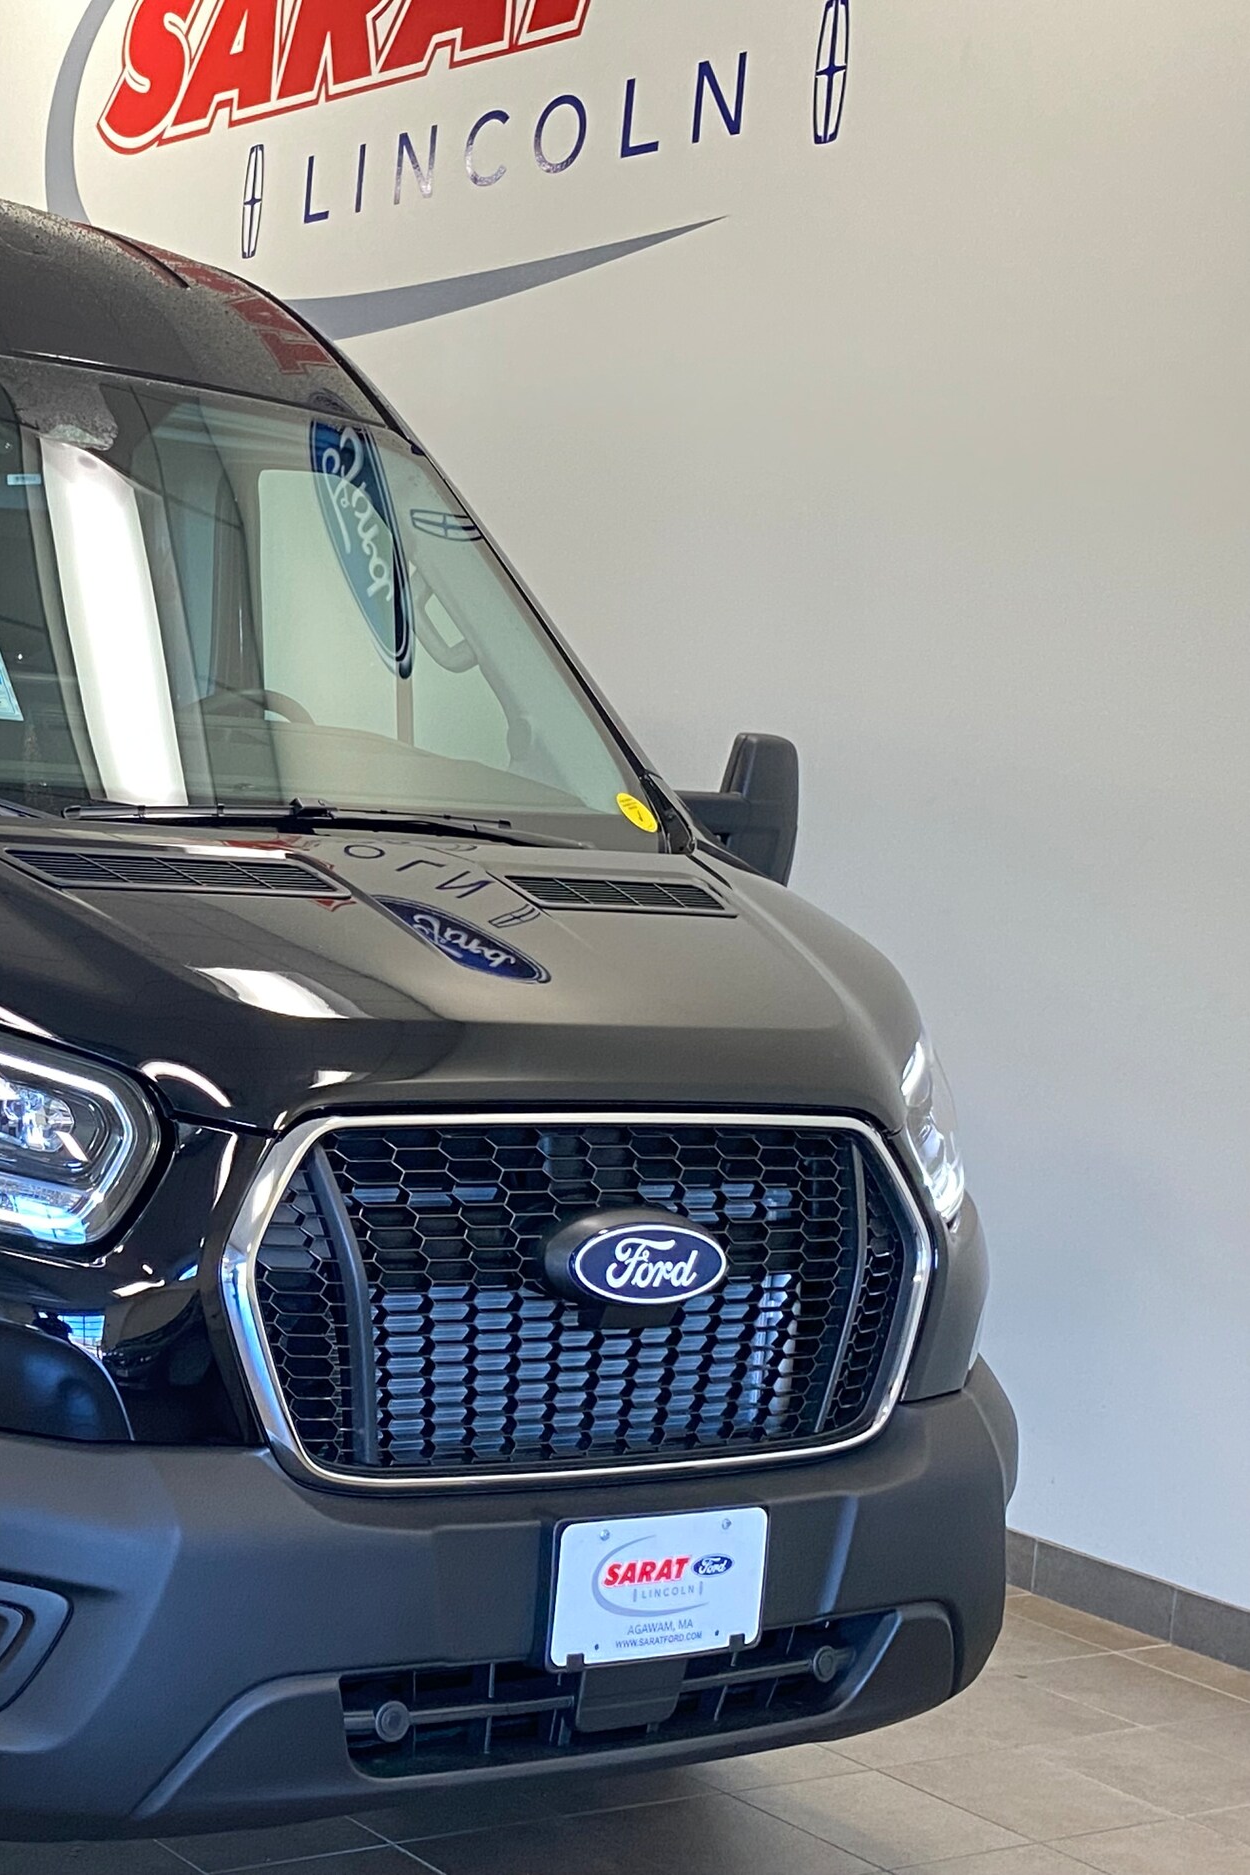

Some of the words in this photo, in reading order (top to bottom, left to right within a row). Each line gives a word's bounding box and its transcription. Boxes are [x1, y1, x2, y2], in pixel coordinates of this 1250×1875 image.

[302, 51, 749, 225] LINCOLN
[606, 1237, 699, 1289] Ford
[603, 1555, 691, 1586] SARAT
[699, 1556, 728, 1576] Ford
[641, 1585, 695, 1599] LINCOLN
[627, 1621, 675, 1635] AGAWAM,
[678, 1619, 693, 1630] MA
[615, 1631, 703, 1648] WWW.SARATFORD.COM
